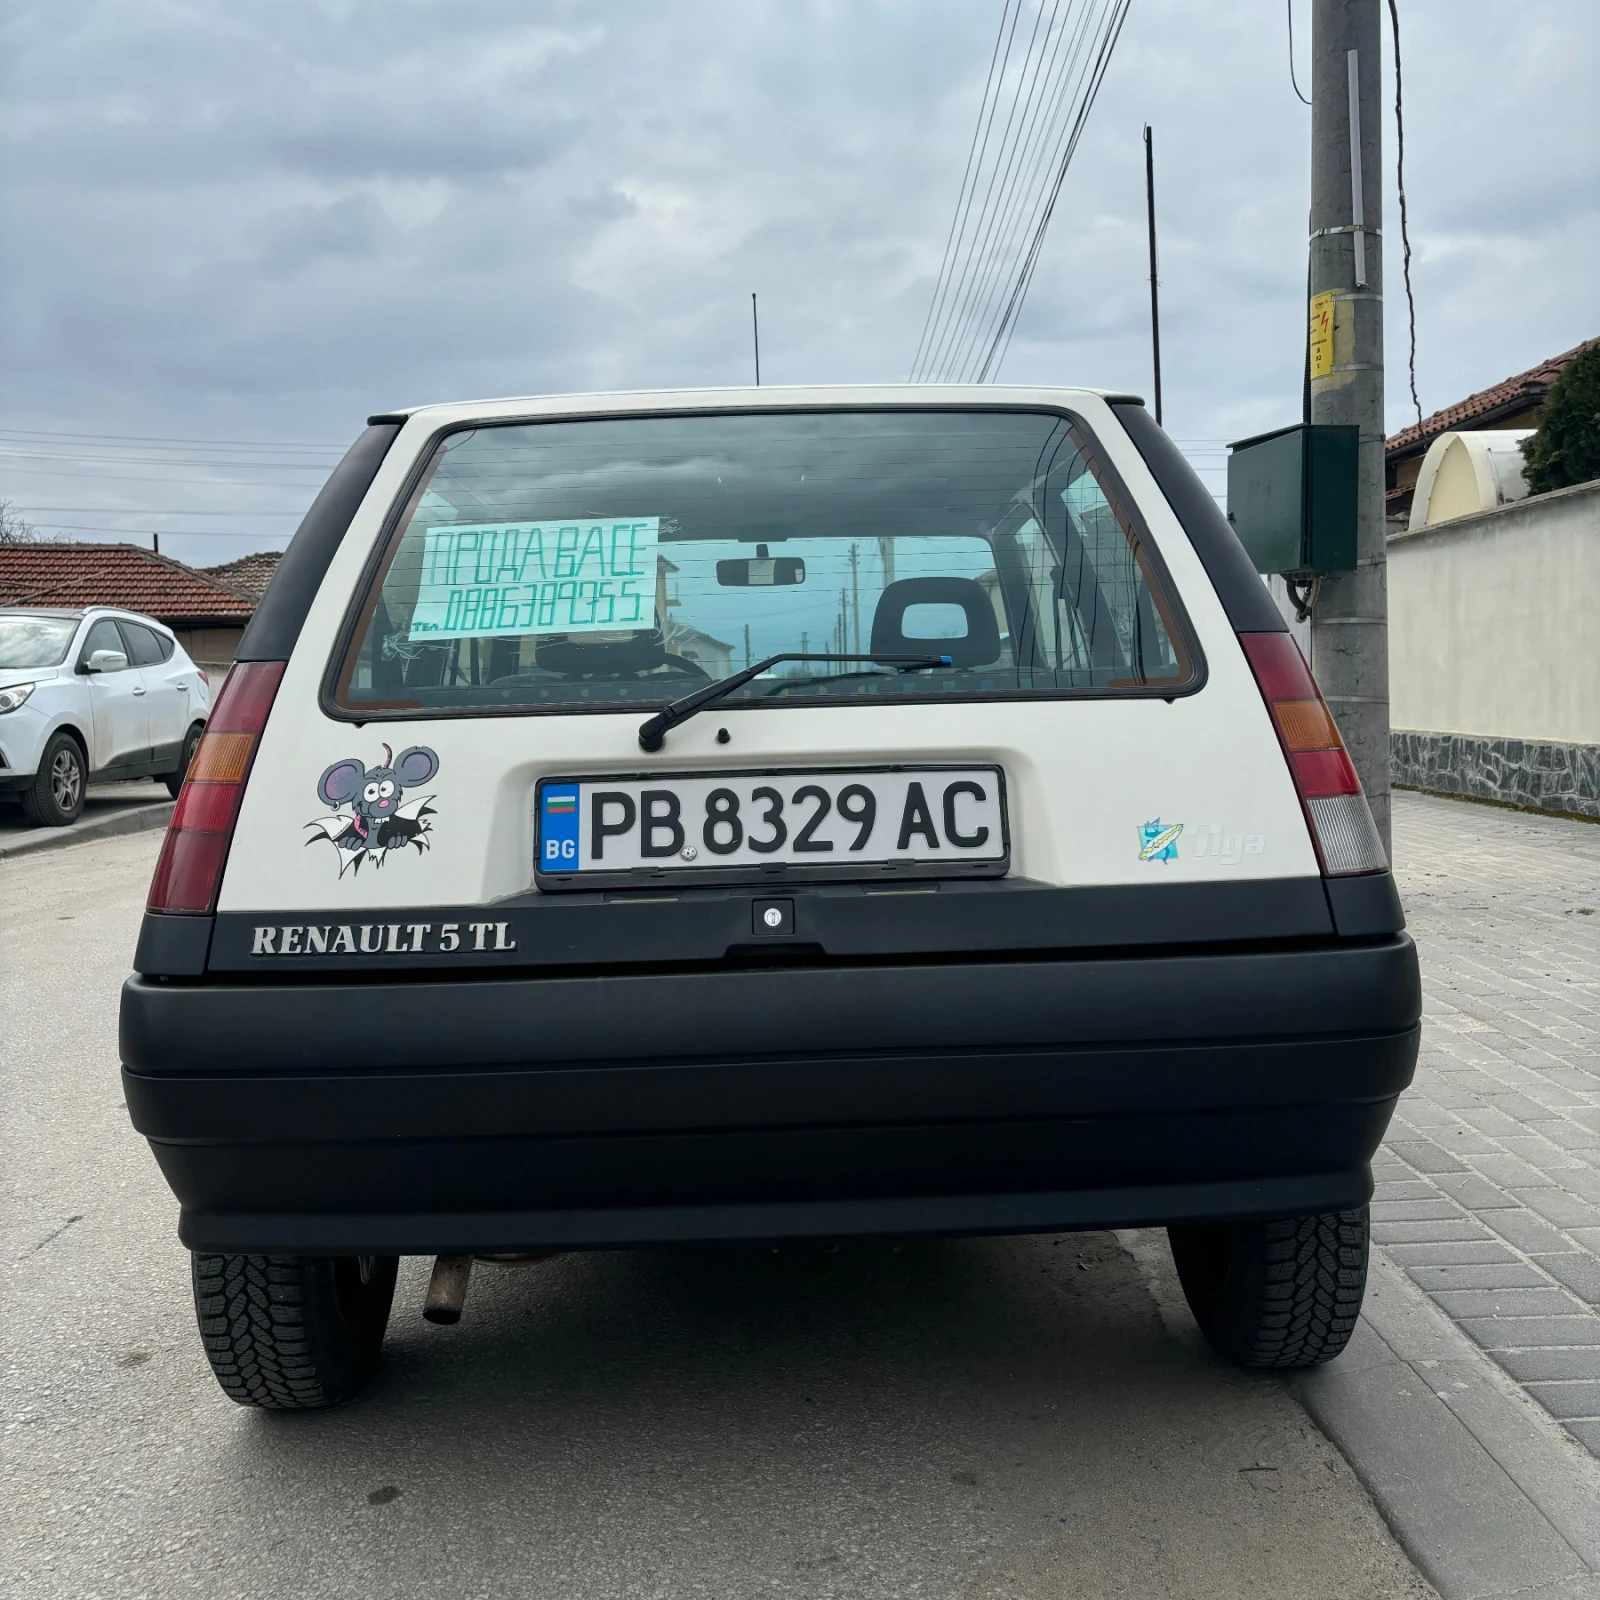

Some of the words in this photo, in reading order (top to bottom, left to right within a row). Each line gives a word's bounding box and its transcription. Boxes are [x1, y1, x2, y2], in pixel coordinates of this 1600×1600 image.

[591, 790, 686, 859] PB
[702, 783, 877, 854] 8329
[897, 780, 989, 849] AC
[545, 839, 576, 859] BG
[250, 923, 431, 955] RENAULT
[439, 923, 461, 951] 5
[469, 921, 517, 950] TL
